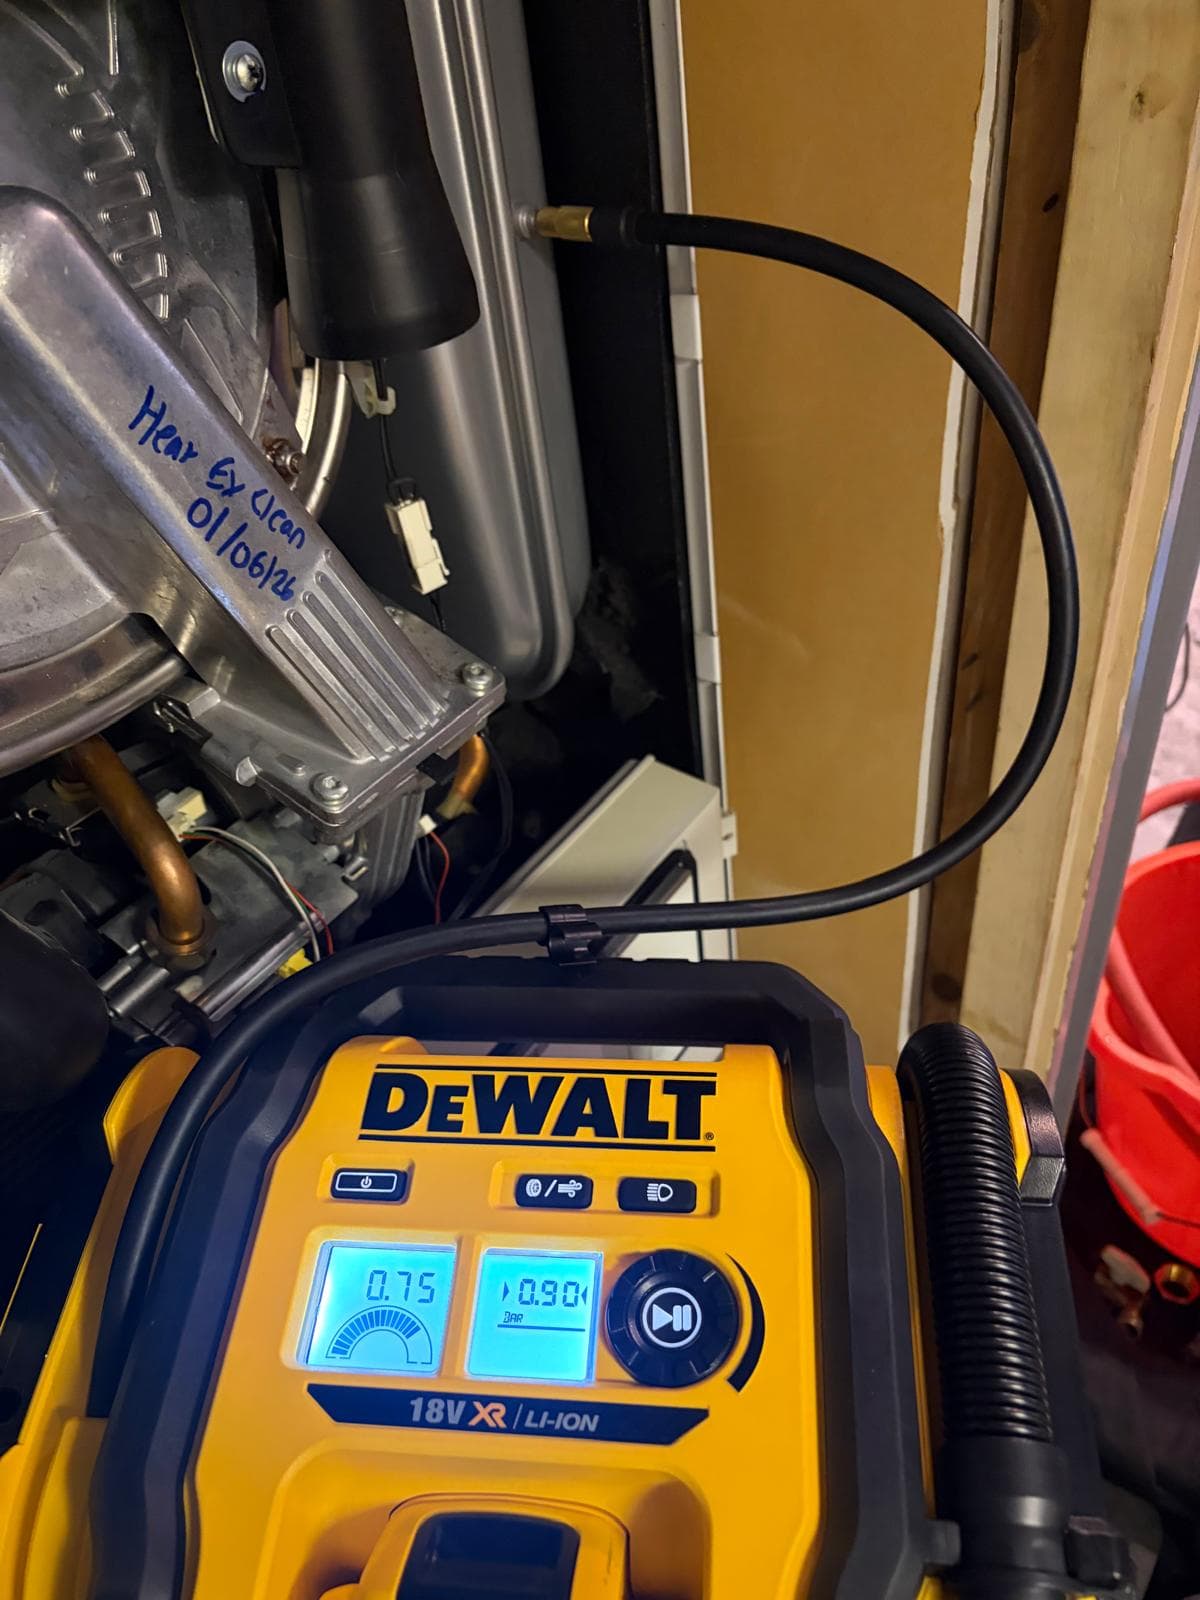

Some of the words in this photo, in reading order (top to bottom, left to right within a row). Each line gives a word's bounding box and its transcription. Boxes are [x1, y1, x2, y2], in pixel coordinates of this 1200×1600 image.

[206, 457, 246, 497] Ex
[366, 1269, 436, 1304] 0.75
[518, 1278, 580, 1308] 0.90
[503, 1311, 525, 1323] BAR
[410, 1397, 466, 1424] 18V
[468, 1402, 506, 1428] XR
[524, 1410, 600, 1432] LI-ION
